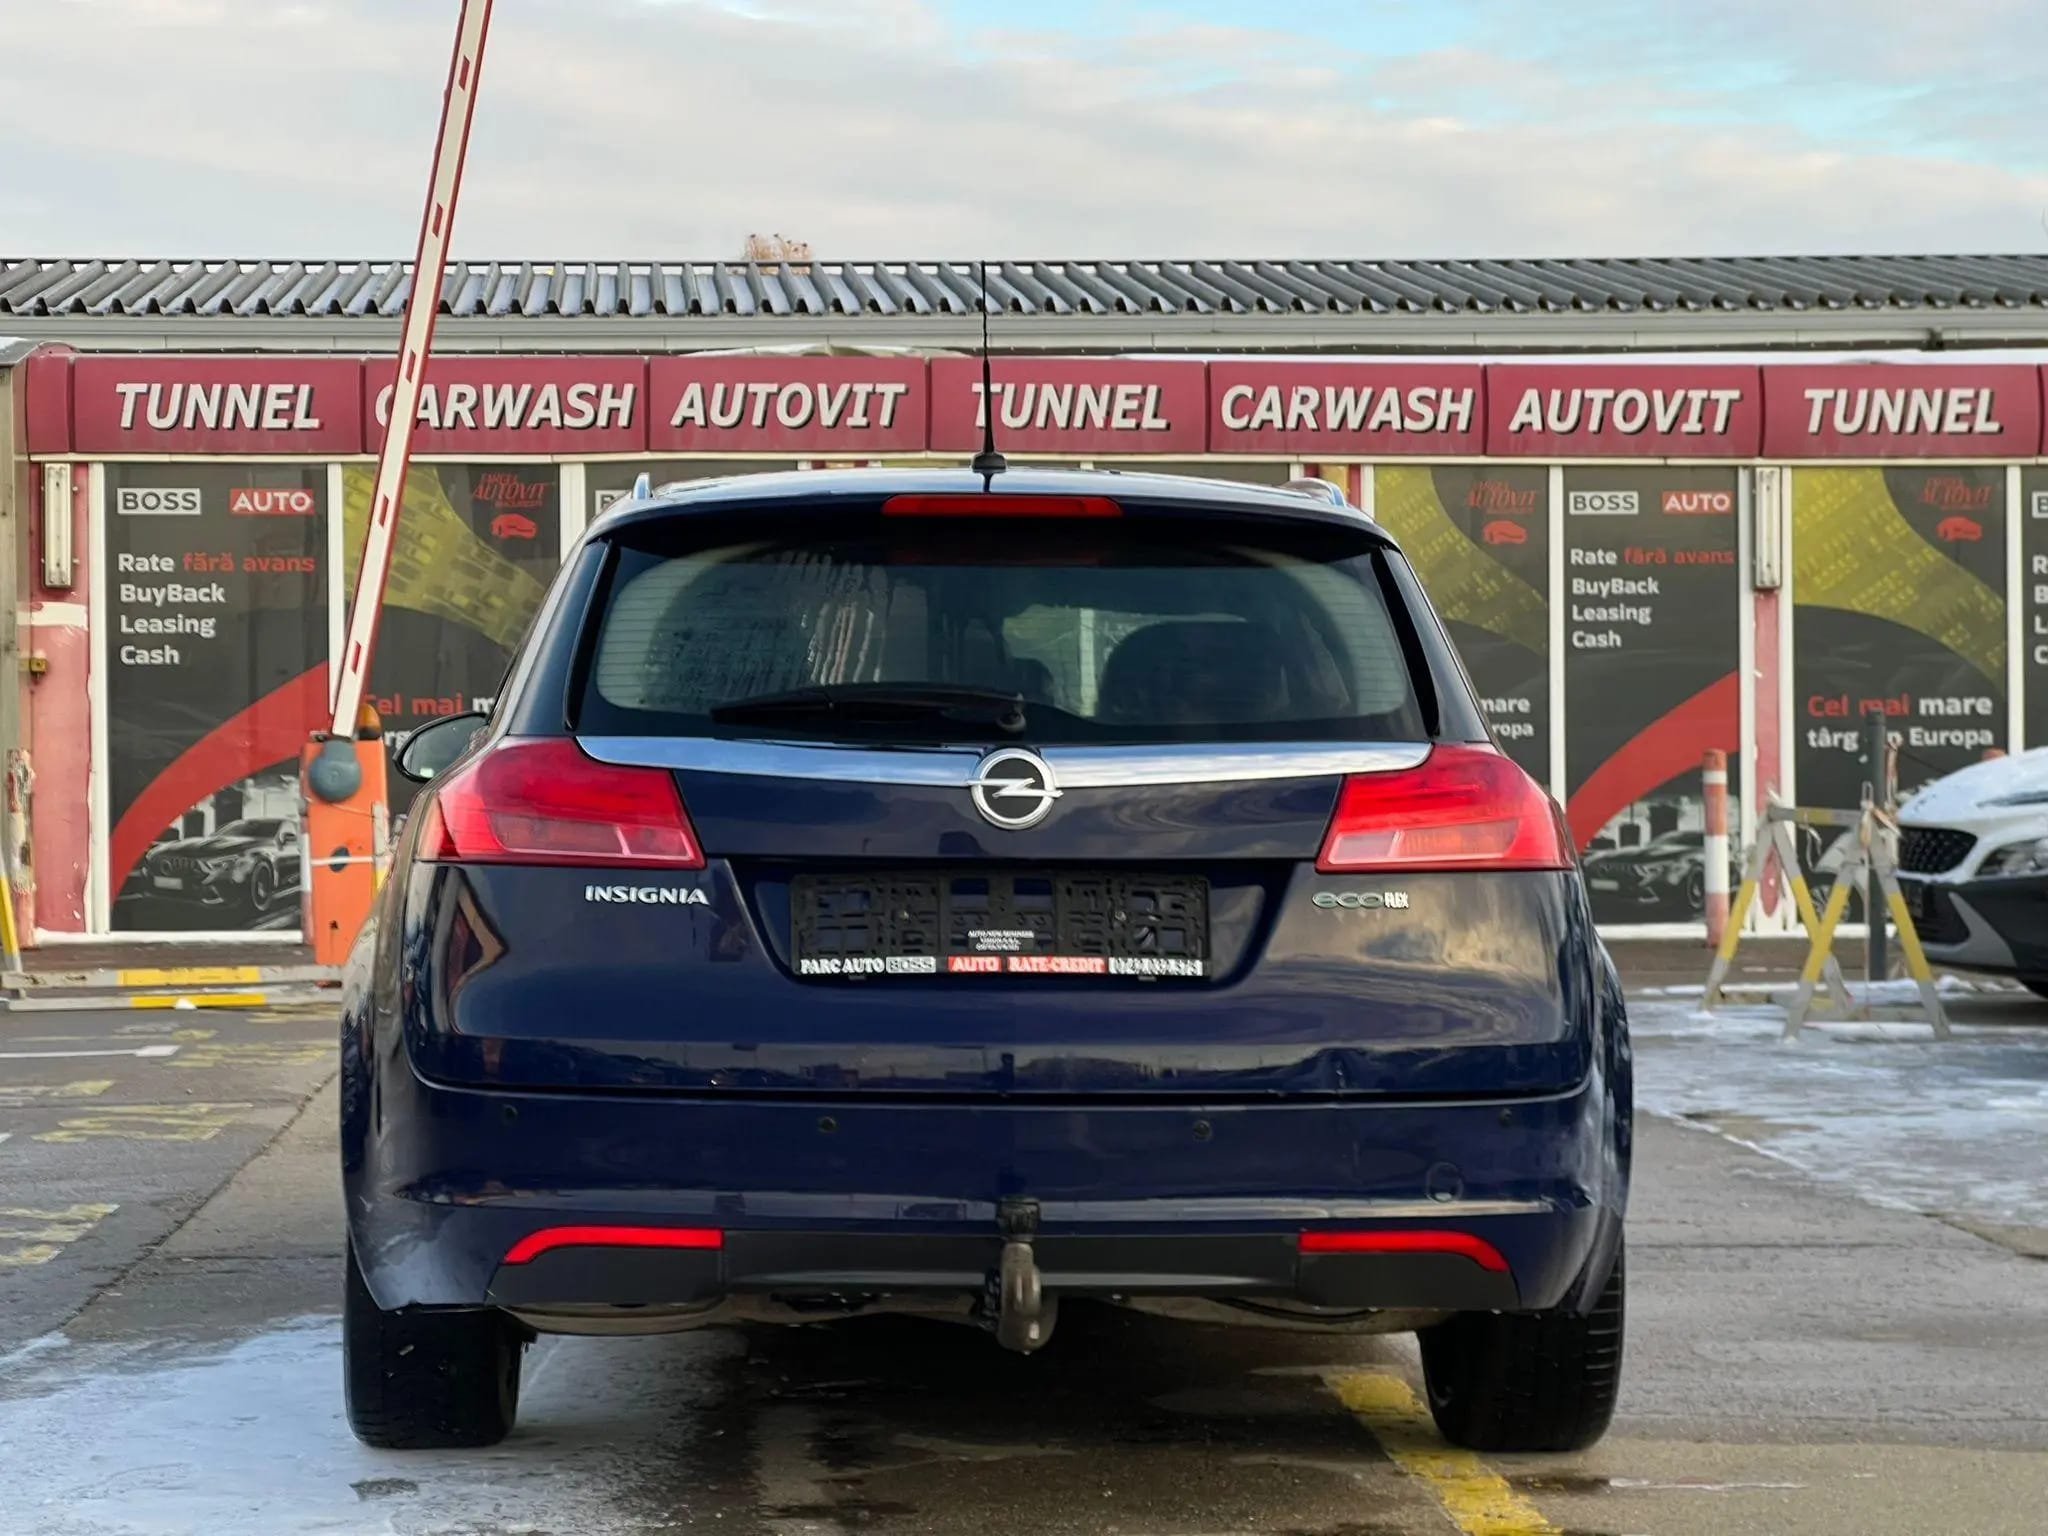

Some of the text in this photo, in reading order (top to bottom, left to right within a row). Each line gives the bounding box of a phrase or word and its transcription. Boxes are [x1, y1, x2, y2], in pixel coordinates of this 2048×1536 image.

[115, 383, 322, 430] TUNNEL
[670, 382, 908, 429] AUTOVIT
[971, 382, 1170, 430] TUNNEL
[1221, 384, 1474, 432] CARWASH
[1508, 388, 1741, 434] AUTOVIT
[1804, 388, 2003, 435] TUNNEL
[120, 490, 198, 512] BOSS
[231, 491, 314, 512] AUTO
[1572, 494, 1636, 512] BOSS
[1664, 493, 1731, 512] AUTO
[118, 552, 315, 573] Rate fără avans
[1570, 548, 1618, 565] Rate
[1674, 551, 1736, 565] avans
[119, 582, 226, 607] BuyBack
[1572, 576, 1660, 598] BuyBack
[1572, 603, 1652, 625] Leasing
[120, 614, 217, 638] Leasing
[1572, 630, 1622, 648] Cash
[120, 645, 180, 665] Cash
[411, 692, 465, 716] mai
[1807, 694, 1849, 718] Cel
[1918, 696, 1993, 717] mare
[1806, 726, 1860, 752] târg
[1908, 726, 1995, 750] Europa
[585, 884, 711, 906] INSIGNIA
[800, 957, 840, 975] PARC
[842, 957, 886, 974] AUTO
[950, 957, 1000, 973] AUTO
